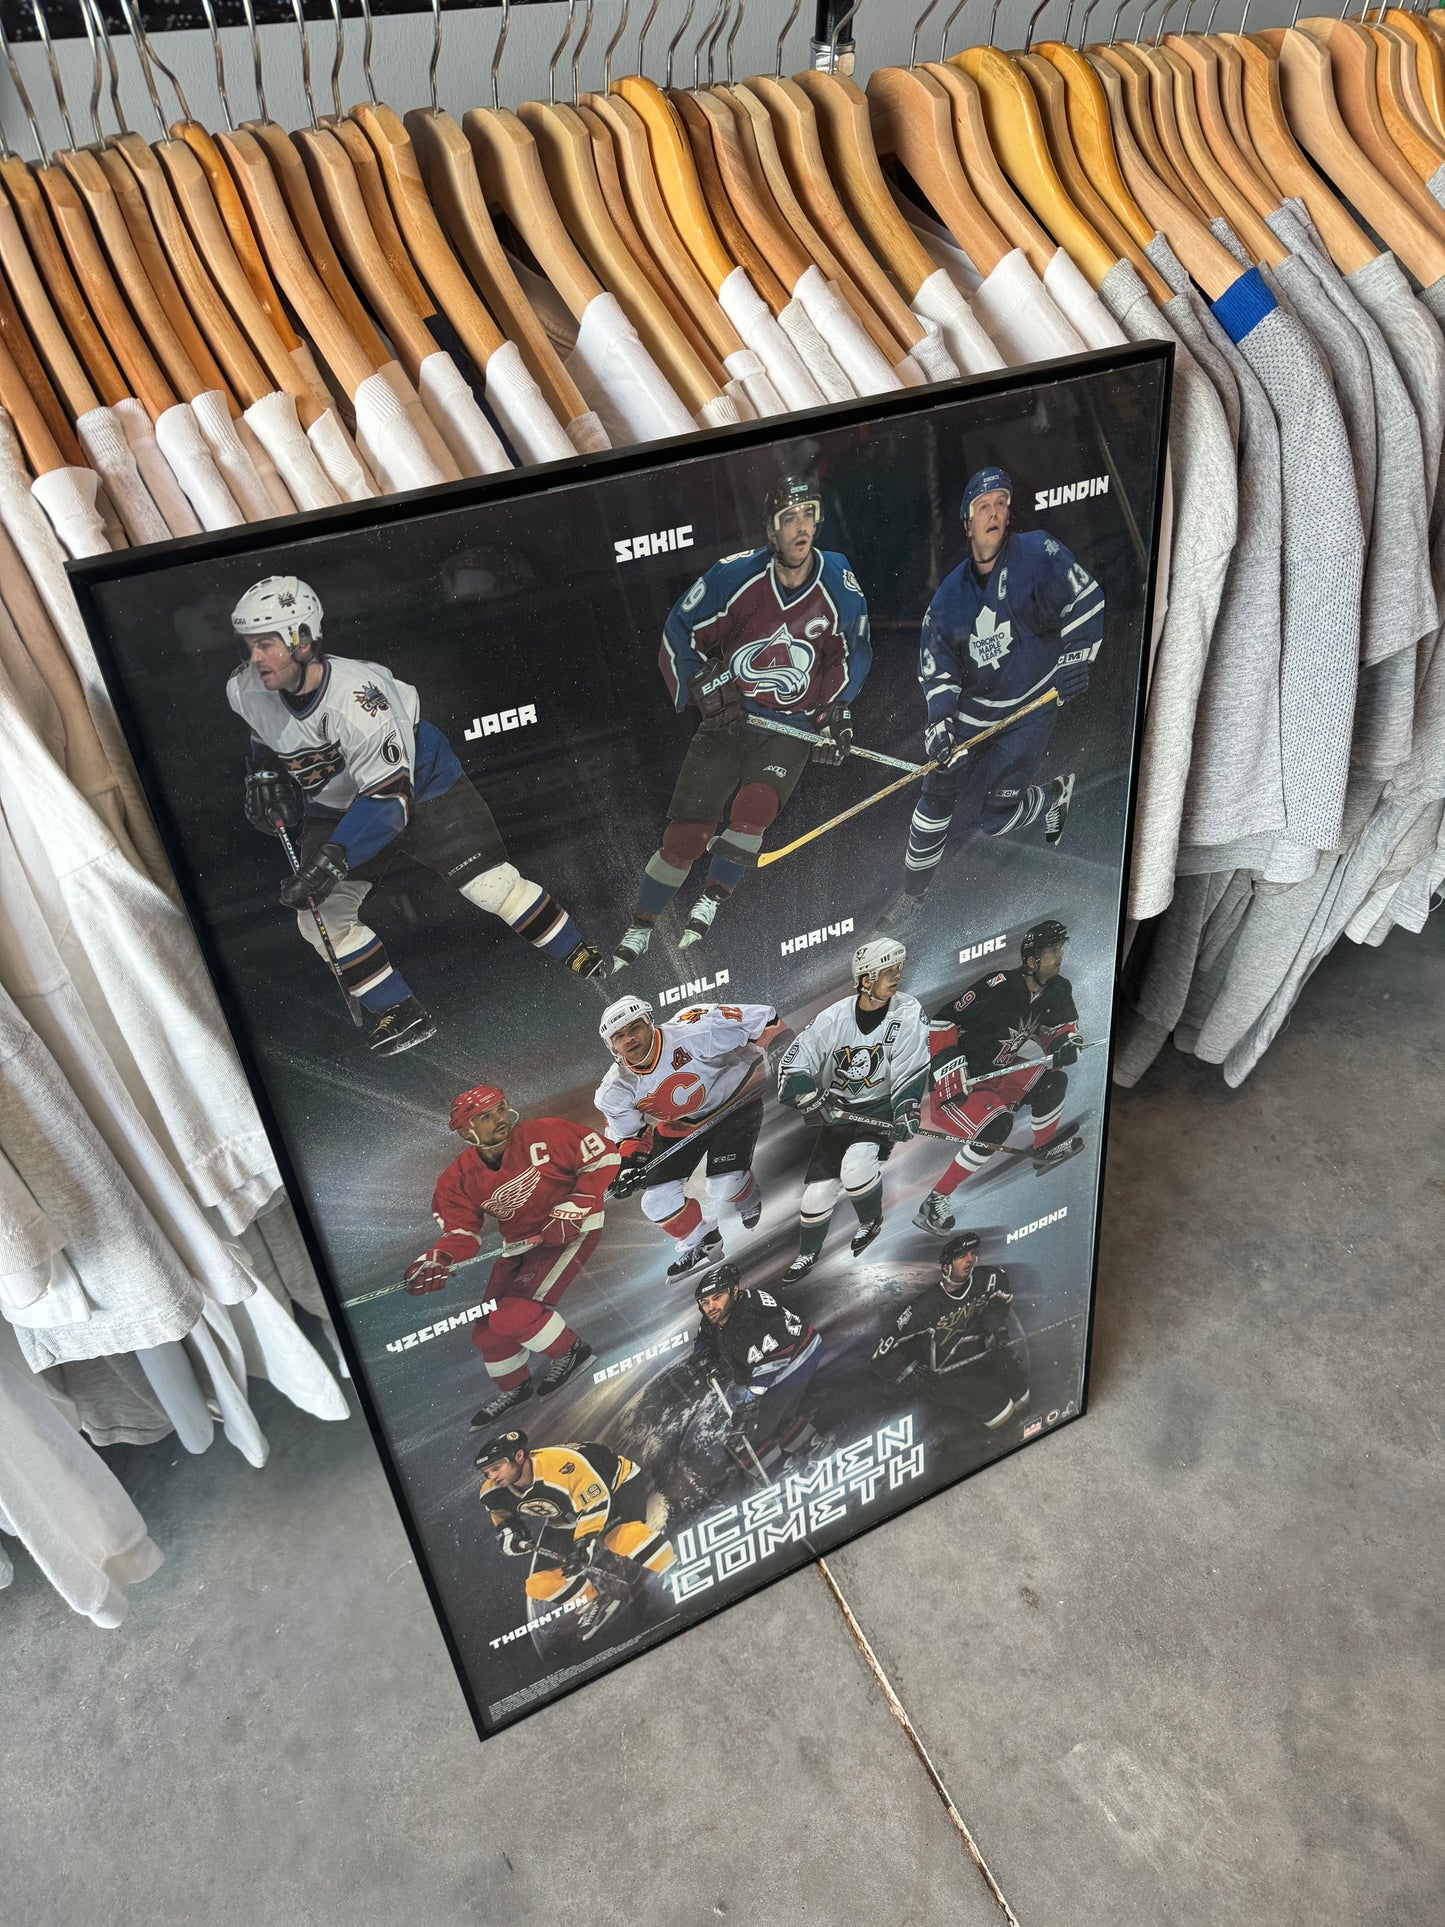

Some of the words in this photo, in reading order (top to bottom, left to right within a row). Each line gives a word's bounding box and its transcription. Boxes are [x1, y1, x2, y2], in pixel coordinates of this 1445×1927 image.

[1034, 475, 1109, 511] SUNDIN
[613, 524, 694, 563] SAKIC
[1067, 563, 1090, 596] 13
[972, 631, 1005, 649] TORONTO
[978, 641, 1001, 656] MAPLE
[981, 648, 1003, 662] LEAFS
[464, 703, 538, 742] JAGR
[380, 729, 409, 767] 6
[780, 917, 855, 957] KARIYA
[959, 934, 1007, 964] BURE
[658, 968, 730, 1007] IGINLA
[529, 1142, 551, 1167] C
[580, 1131, 607, 1164] 19
[1006, 1206, 1068, 1245] MODANO
[986, 1273, 997, 1292] A
[386, 1298, 498, 1353] YZERMAN
[592, 1331, 690, 1385] BERTUZZI
[746, 1332, 780, 1365] 44
[577, 1483, 603, 1507] 19
[676, 1413, 914, 1566] ICEMEN
[670, 1442, 926, 1605] COMETH
[488, 1594, 589, 1650] THORNTON
